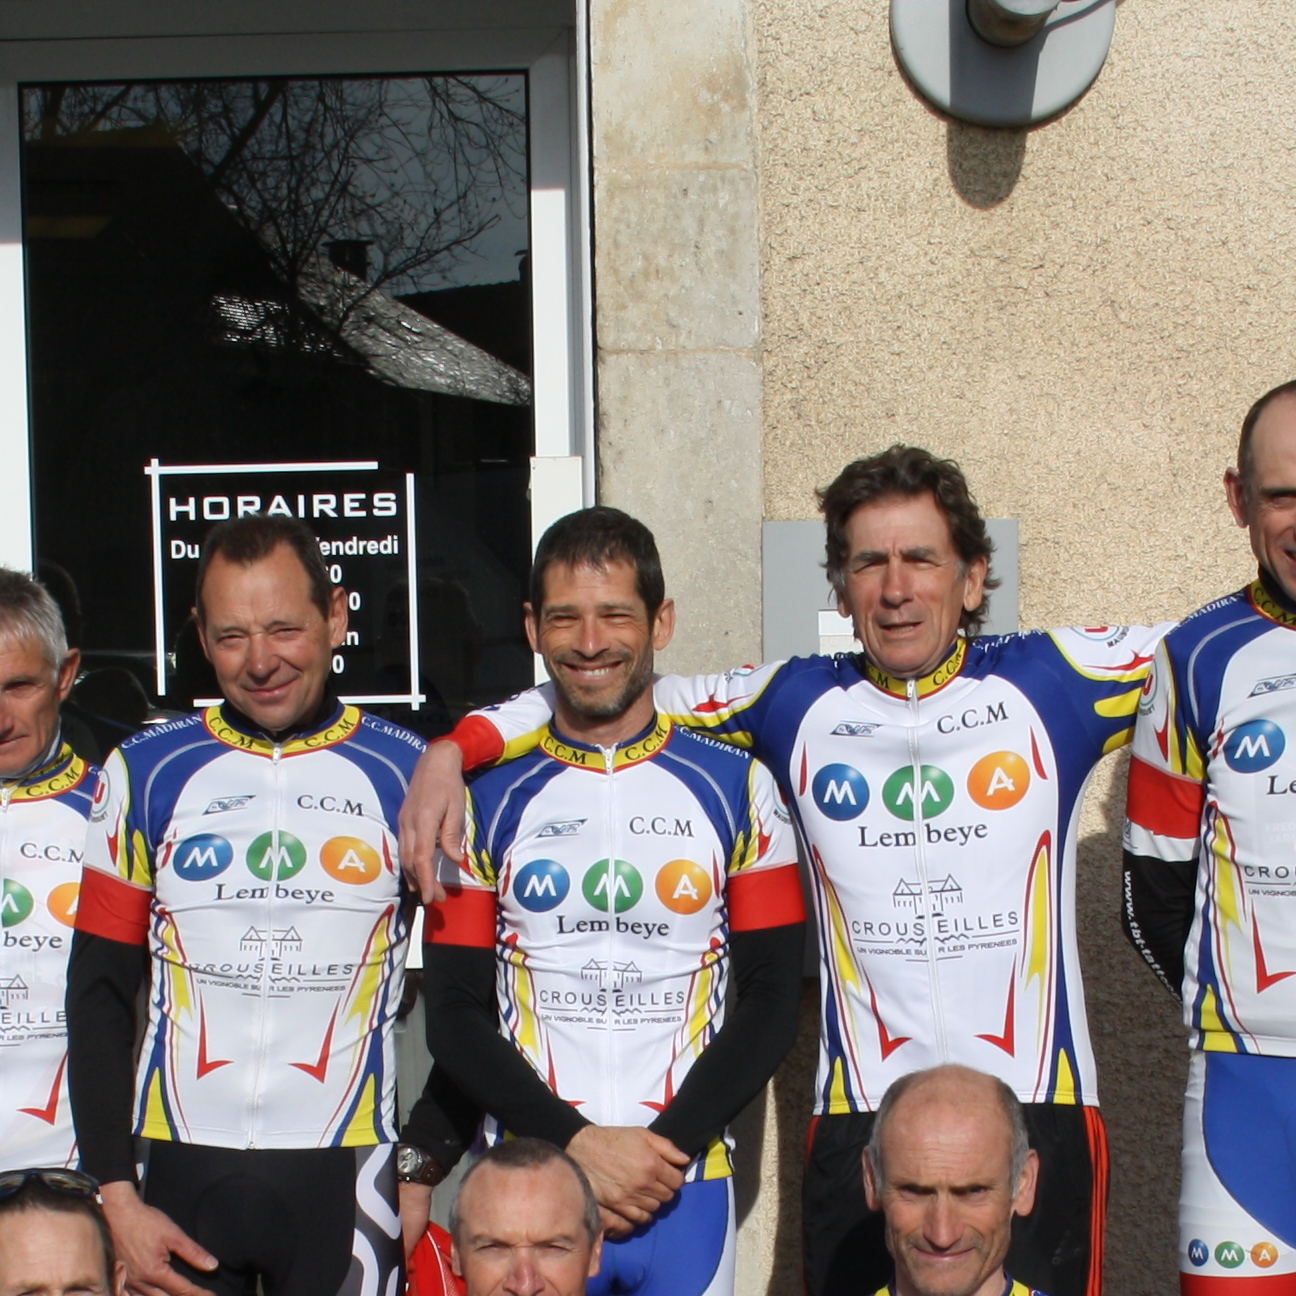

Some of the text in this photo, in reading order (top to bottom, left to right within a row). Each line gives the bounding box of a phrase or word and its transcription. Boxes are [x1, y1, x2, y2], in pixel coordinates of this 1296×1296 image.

[169, 492, 398, 521] HORAIRES
[170, 535, 399, 560] Du endredi
[121, 714, 203, 750] C.C.MADIRAN
[207, 715, 255, 750] C.C.M
[304, 717, 356, 748] C.C.M
[936, 701, 1010, 736] C.C.M
[360, 714, 428, 754] C.C.MADIRA
[624, 726, 669, 761] C.C.M
[543, 736, 588, 766] C.C.M
[297, 793, 365, 817] C.C.M
[629, 816, 695, 838] C.C.M
[857, 821, 989, 849] Lembeye
[215, 882, 335, 903] Lembeye
[556, 915, 670, 938] Lembeye
[851, 910, 1020, 938] CROUSEILLES
[190, 962, 354, 977] CROUSEILLES
[539, 988, 686, 1007] CROUSEILLES
